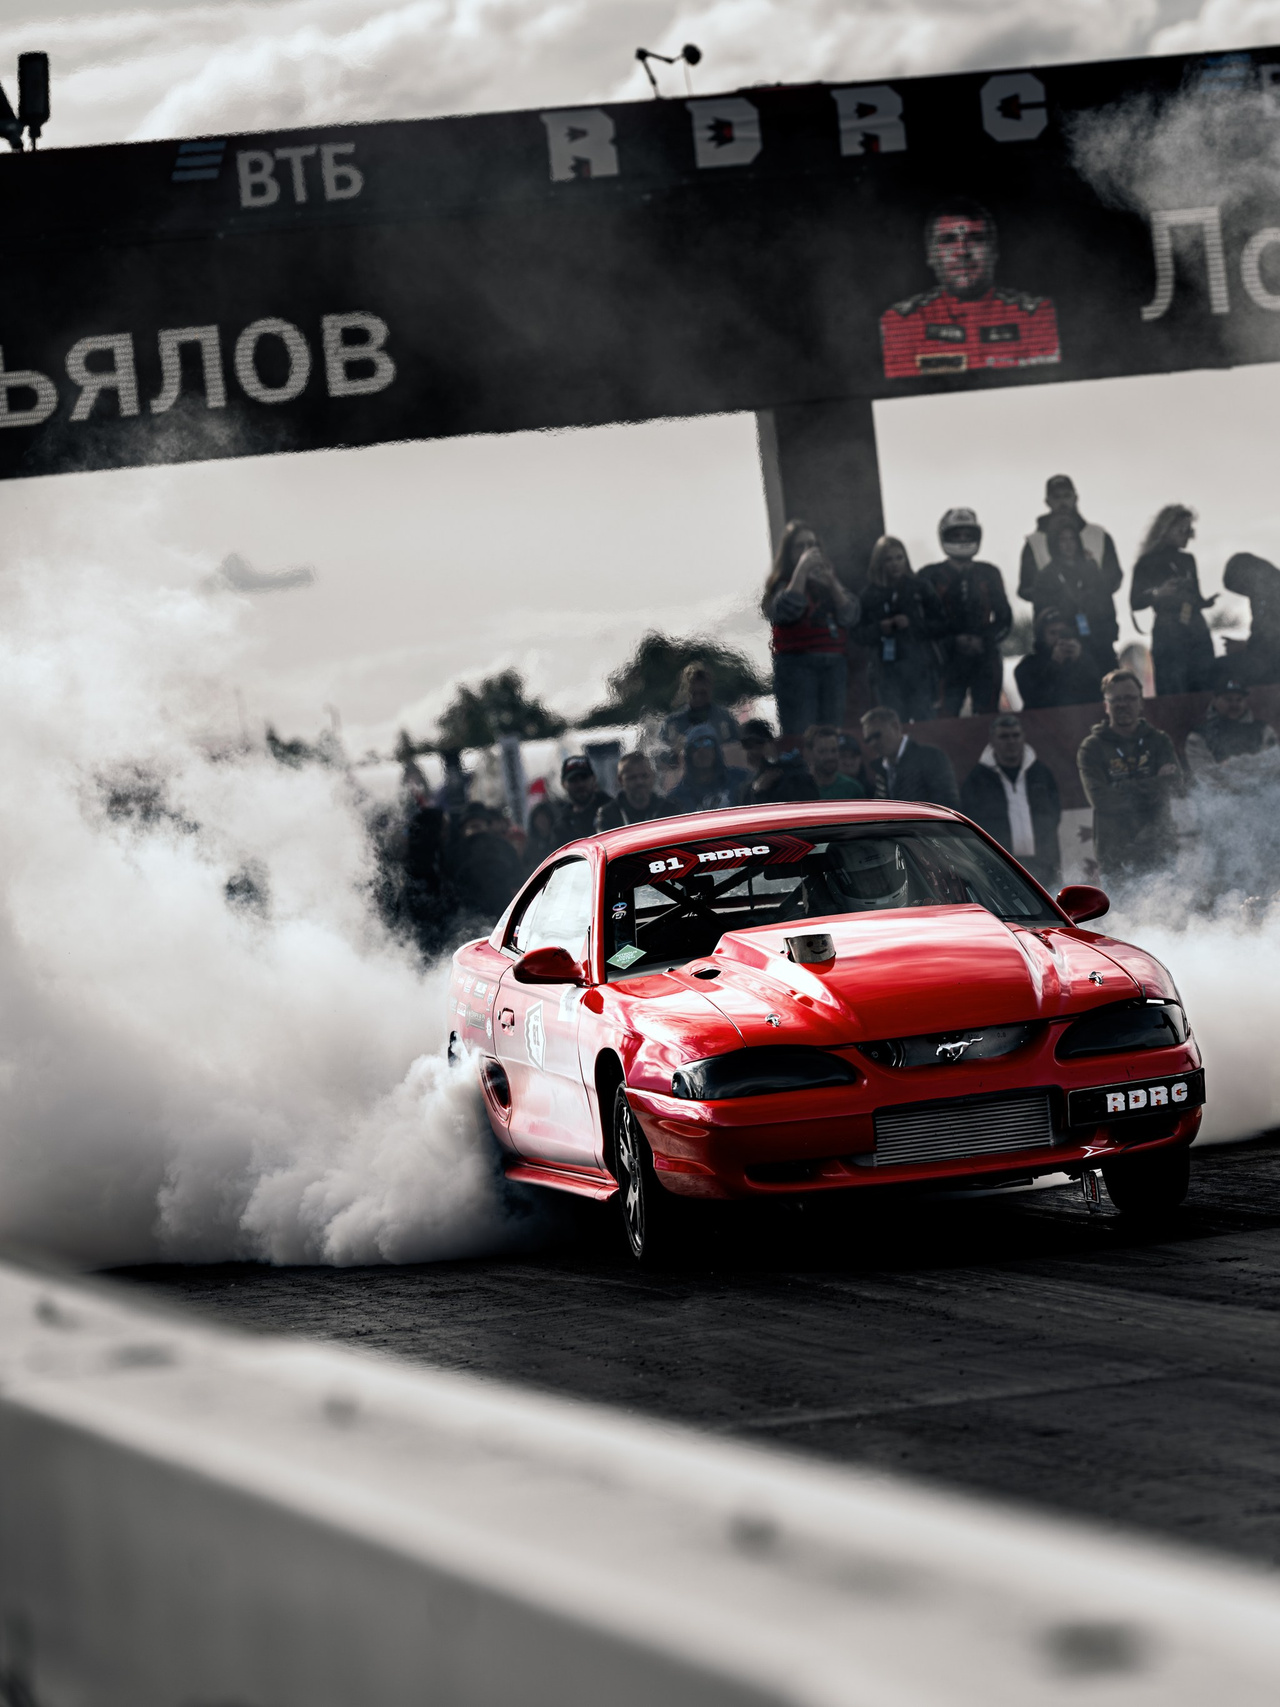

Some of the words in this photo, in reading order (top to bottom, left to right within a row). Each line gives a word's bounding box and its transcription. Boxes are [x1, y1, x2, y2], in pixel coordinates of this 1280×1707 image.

[236, 143, 364, 209] ВТБ
[649, 857, 684, 874] 81
[697, 846, 770, 862] RDRC
[1106, 1082, 1188, 1113] RDRC
